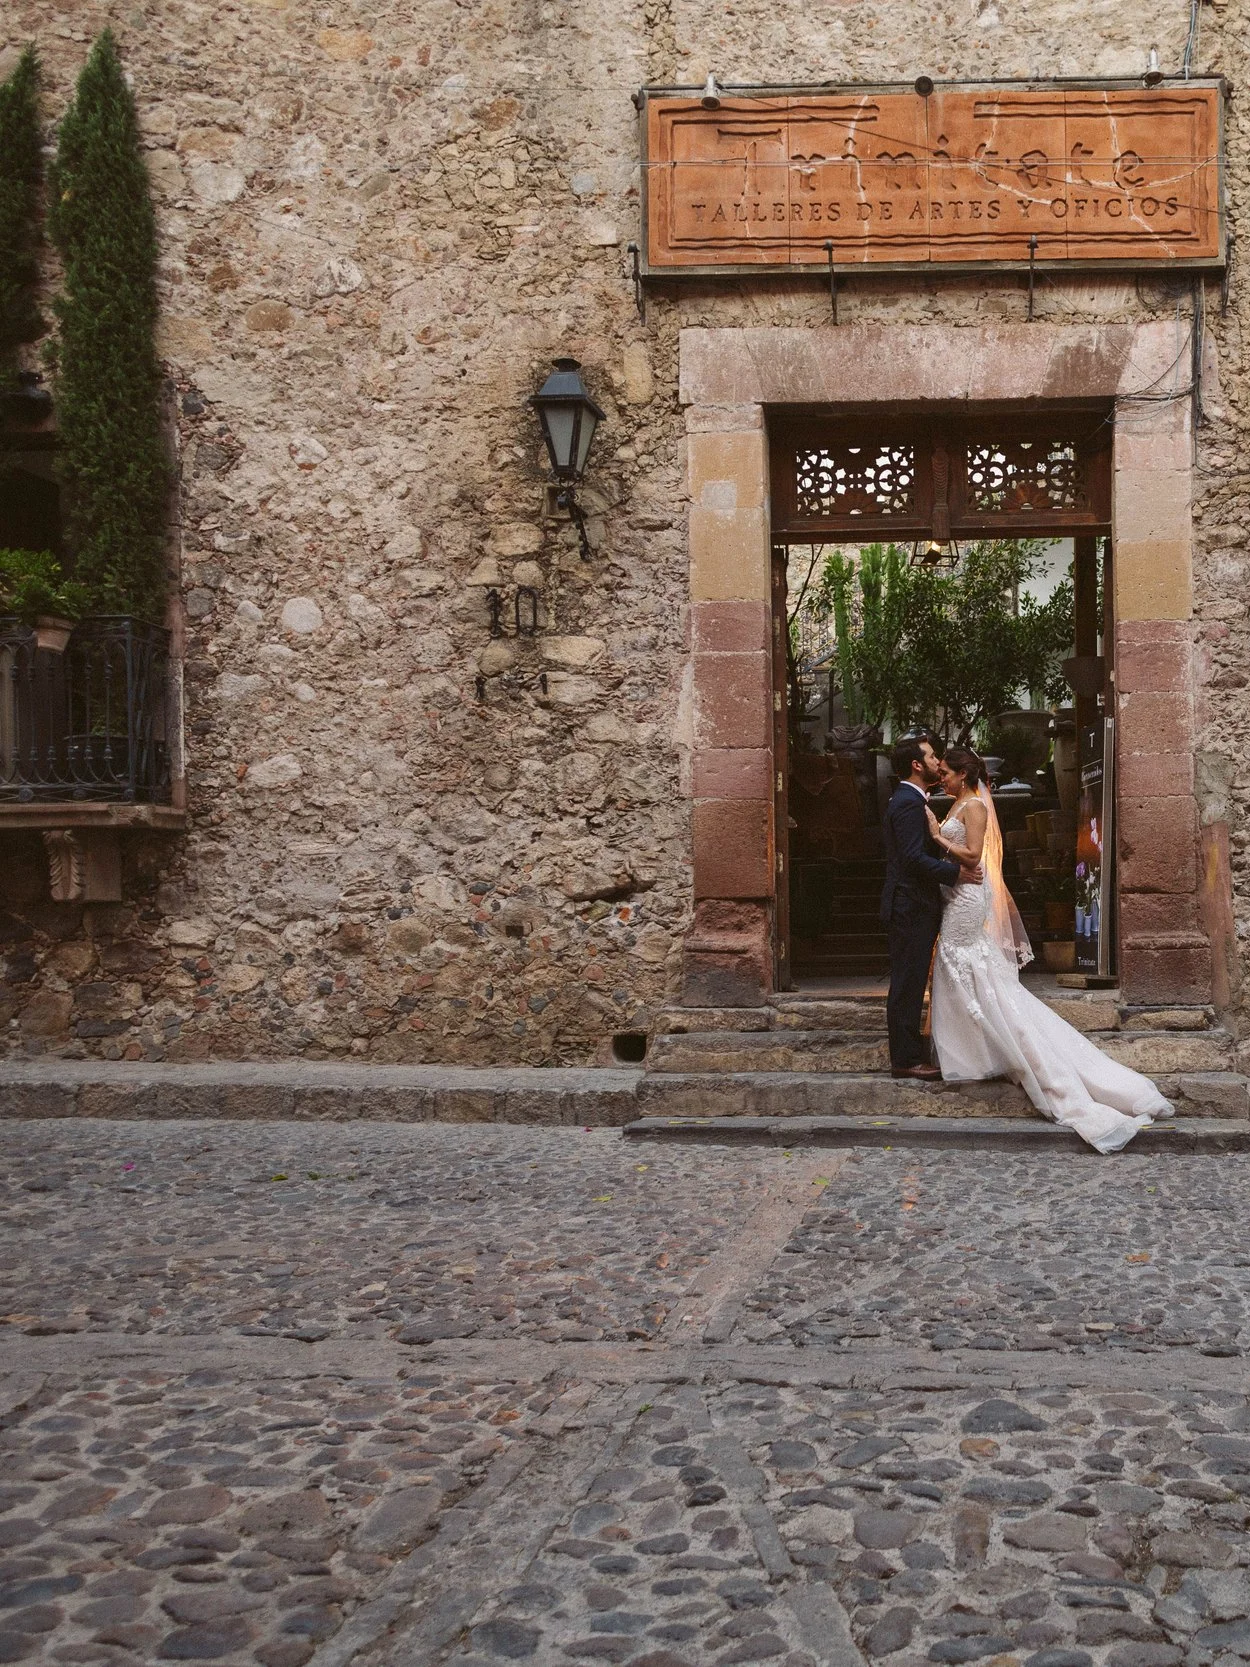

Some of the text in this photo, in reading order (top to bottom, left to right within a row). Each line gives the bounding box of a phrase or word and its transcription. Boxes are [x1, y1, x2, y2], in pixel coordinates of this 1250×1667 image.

[716, 128, 1145, 196] Trinitate
[691, 196, 1179, 222] TALLERES DE ARTES Y OFICIOS
